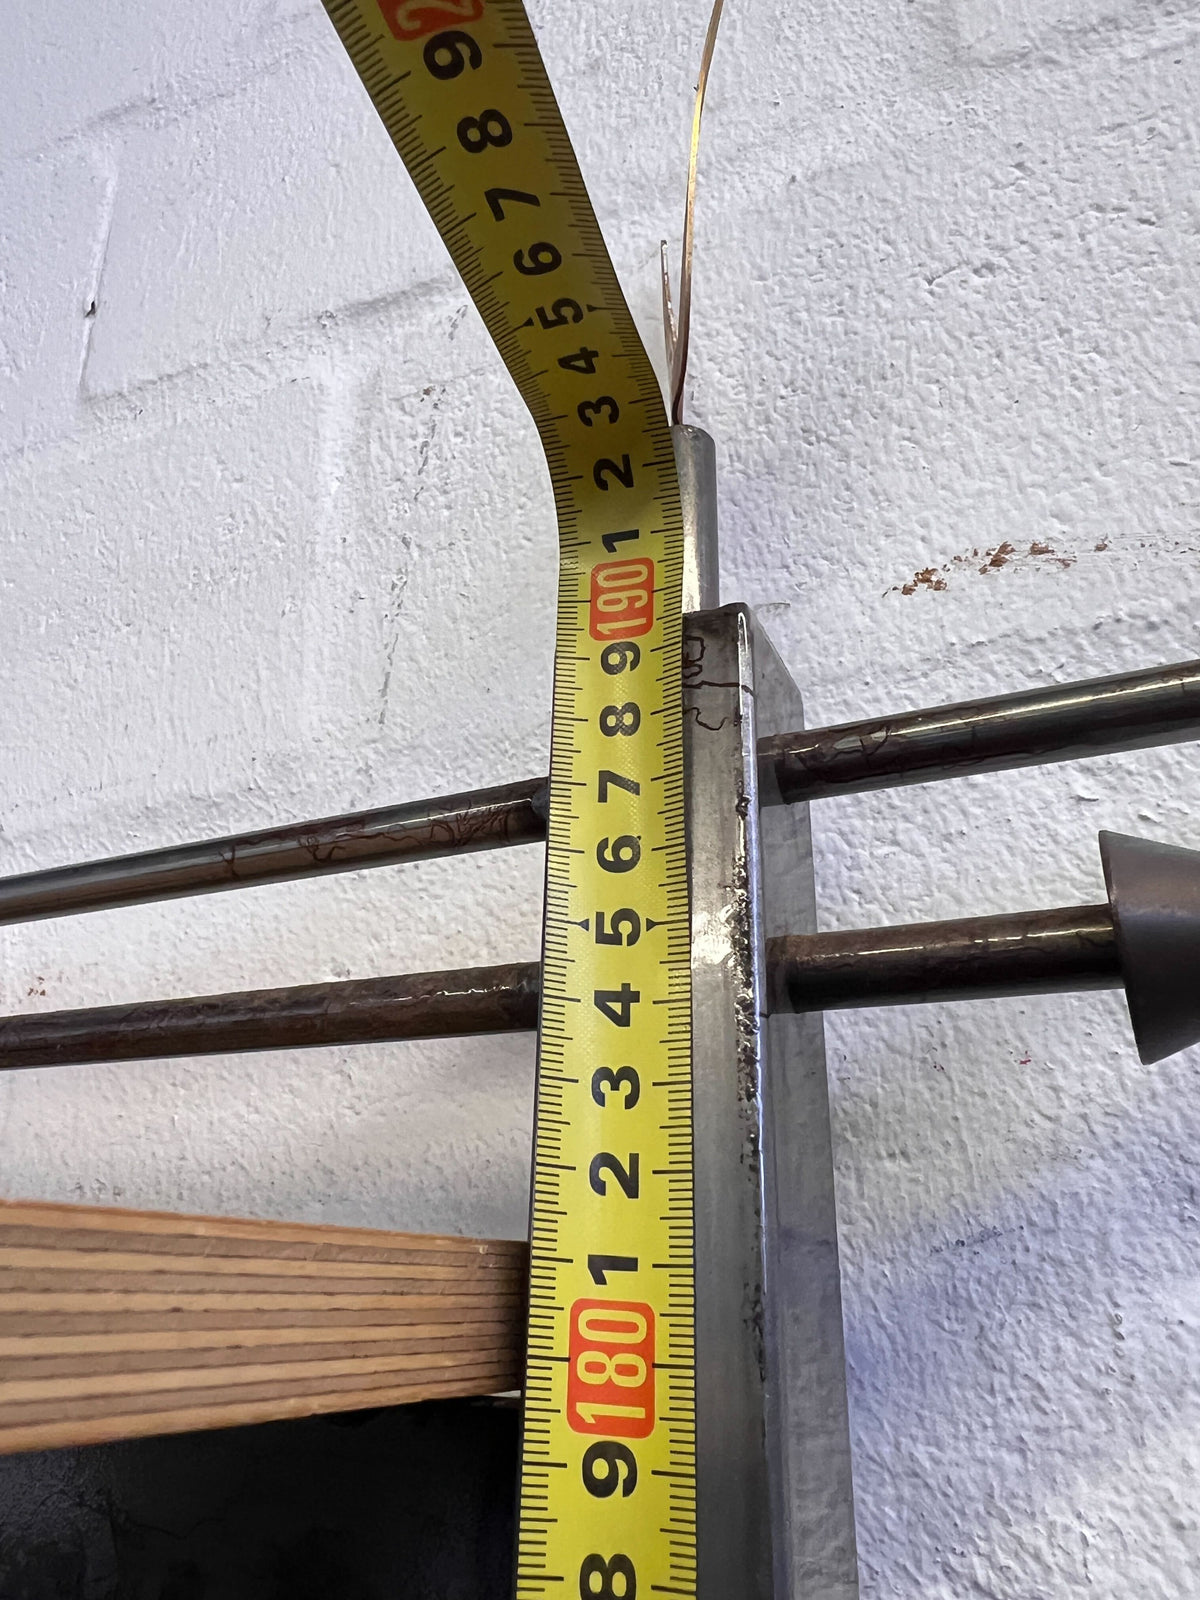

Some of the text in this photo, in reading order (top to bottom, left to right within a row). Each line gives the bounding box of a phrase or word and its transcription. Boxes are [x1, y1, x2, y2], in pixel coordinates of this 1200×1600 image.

[423, 30, 482, 80] 9
[457, 109, 512, 153] 8
[485, 188, 541, 221] 7
[513, 242, 562, 275] 6
[535, 298, 583, 330] 5
[558, 347, 599, 373] 4
[577, 395, 620, 427] 3
[593, 454, 634, 491] 2
[602, 529, 639, 553] 1
[596, 564, 648, 636] 190
[600, 641, 640, 676] 9
[600, 702, 641, 737] 8
[598, 770, 640, 803] 7
[597, 835, 641, 873] 6
[595, 908, 640, 947] 5
[594, 983, 640, 1027] 4
[591, 1066, 639, 1110] 3
[589, 1152, 639, 1199] 2
[587, 1254, 638, 1286] 1
[575, 1308, 647, 1424] 180
[582, 1441, 638, 1498] 9
[580, 1553, 636, 1600] 8
